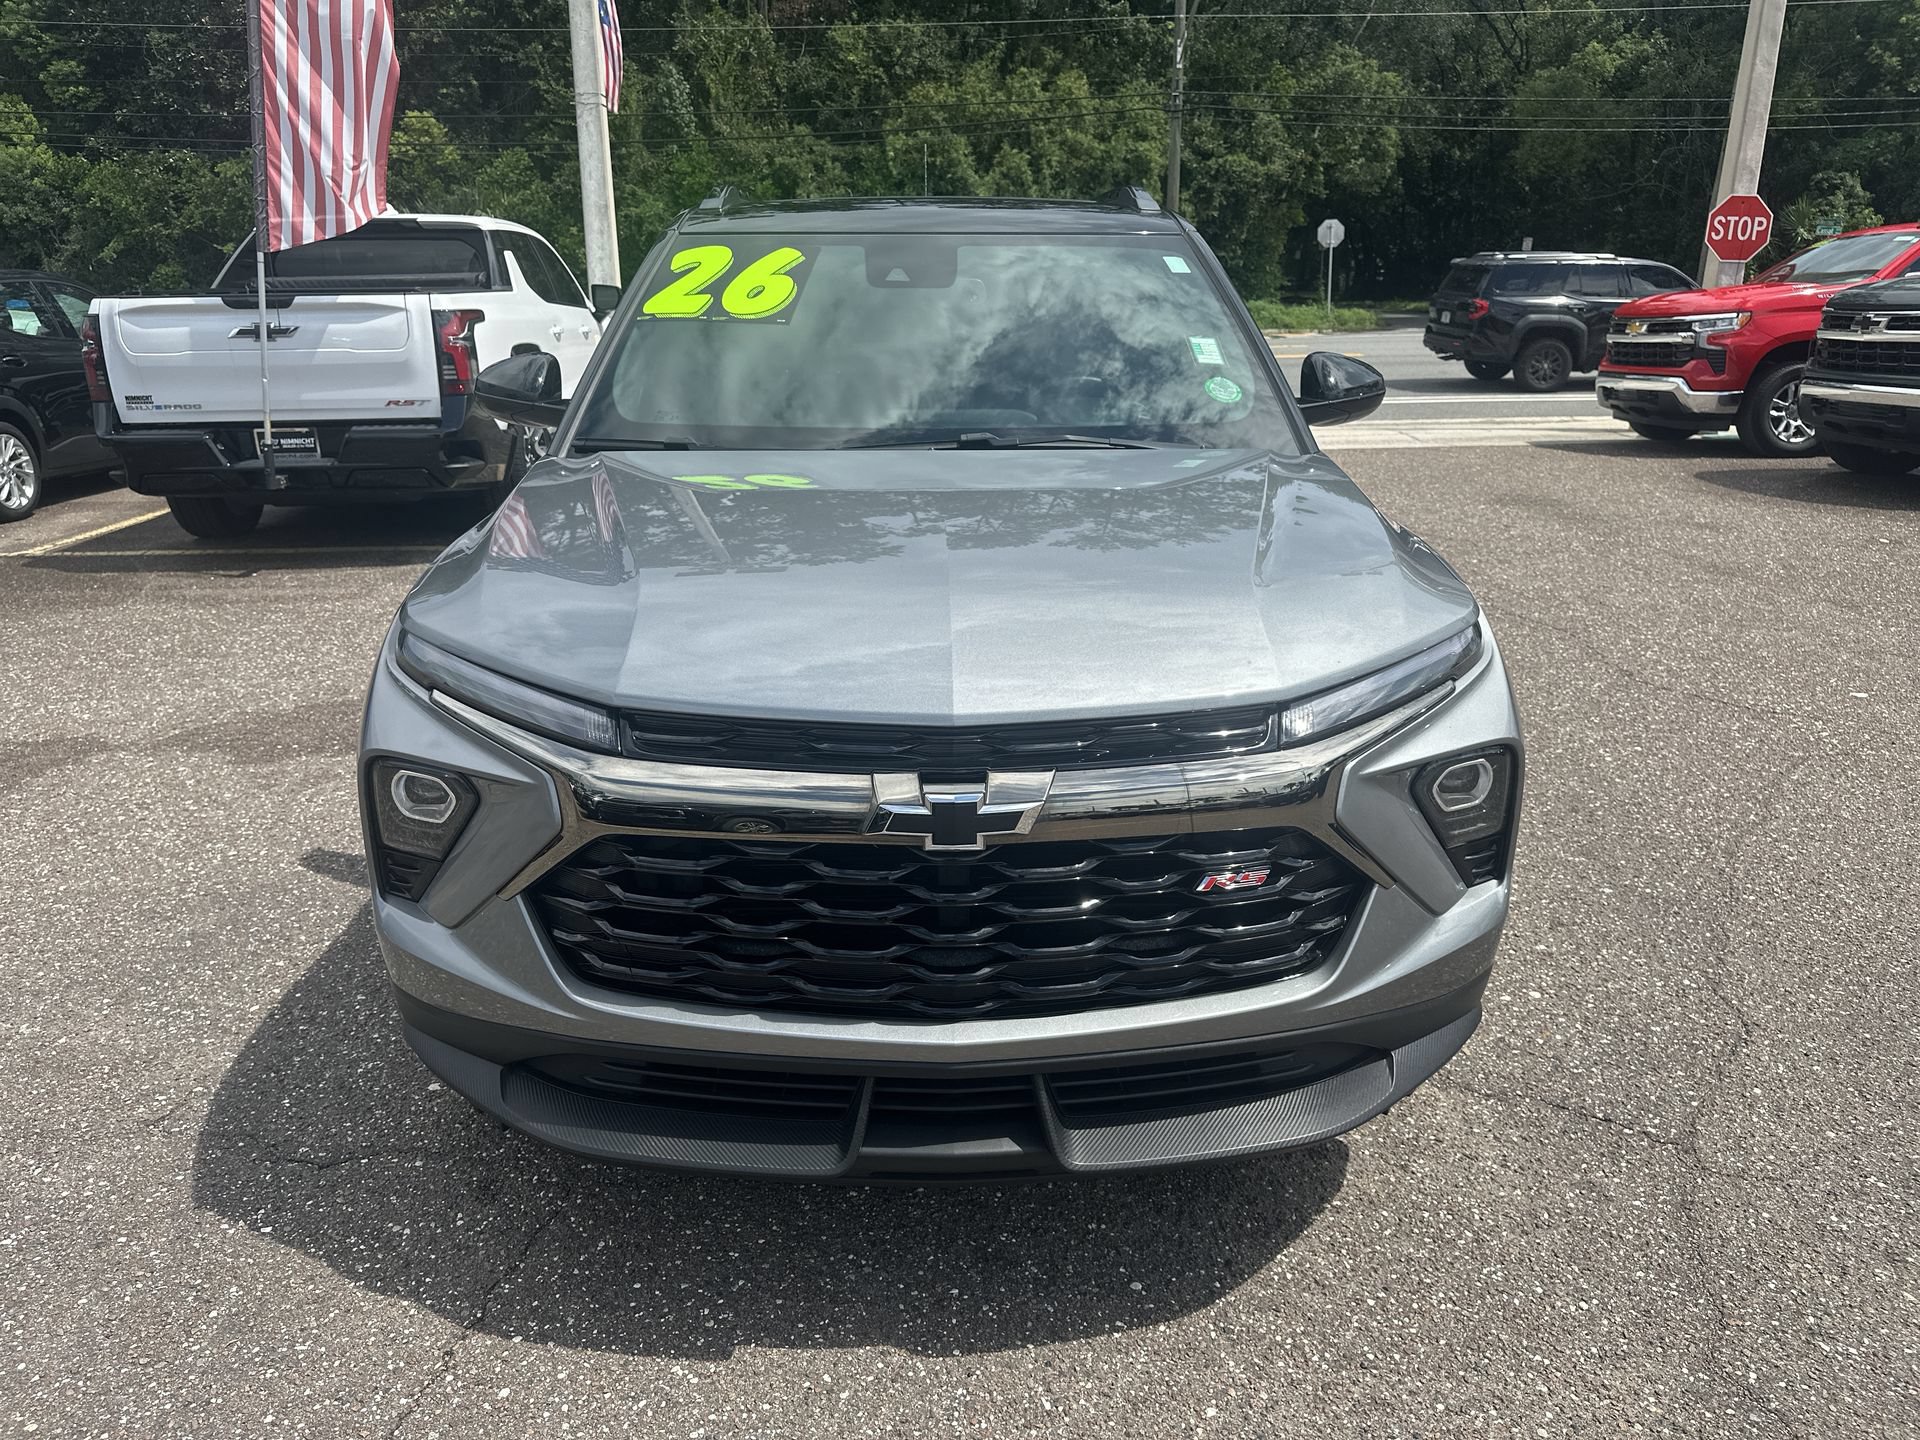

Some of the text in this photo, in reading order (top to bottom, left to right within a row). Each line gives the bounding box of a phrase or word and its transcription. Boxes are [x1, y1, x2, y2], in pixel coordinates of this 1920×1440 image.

[1711, 215, 1768, 241] STOP
[643, 245, 806, 319] 26
[126, 403, 203, 411] SILVERADO
[384, 399, 432, 407] RST
[280, 437, 315, 445] NIMNICHT
[1196, 869, 1270, 892] RS
